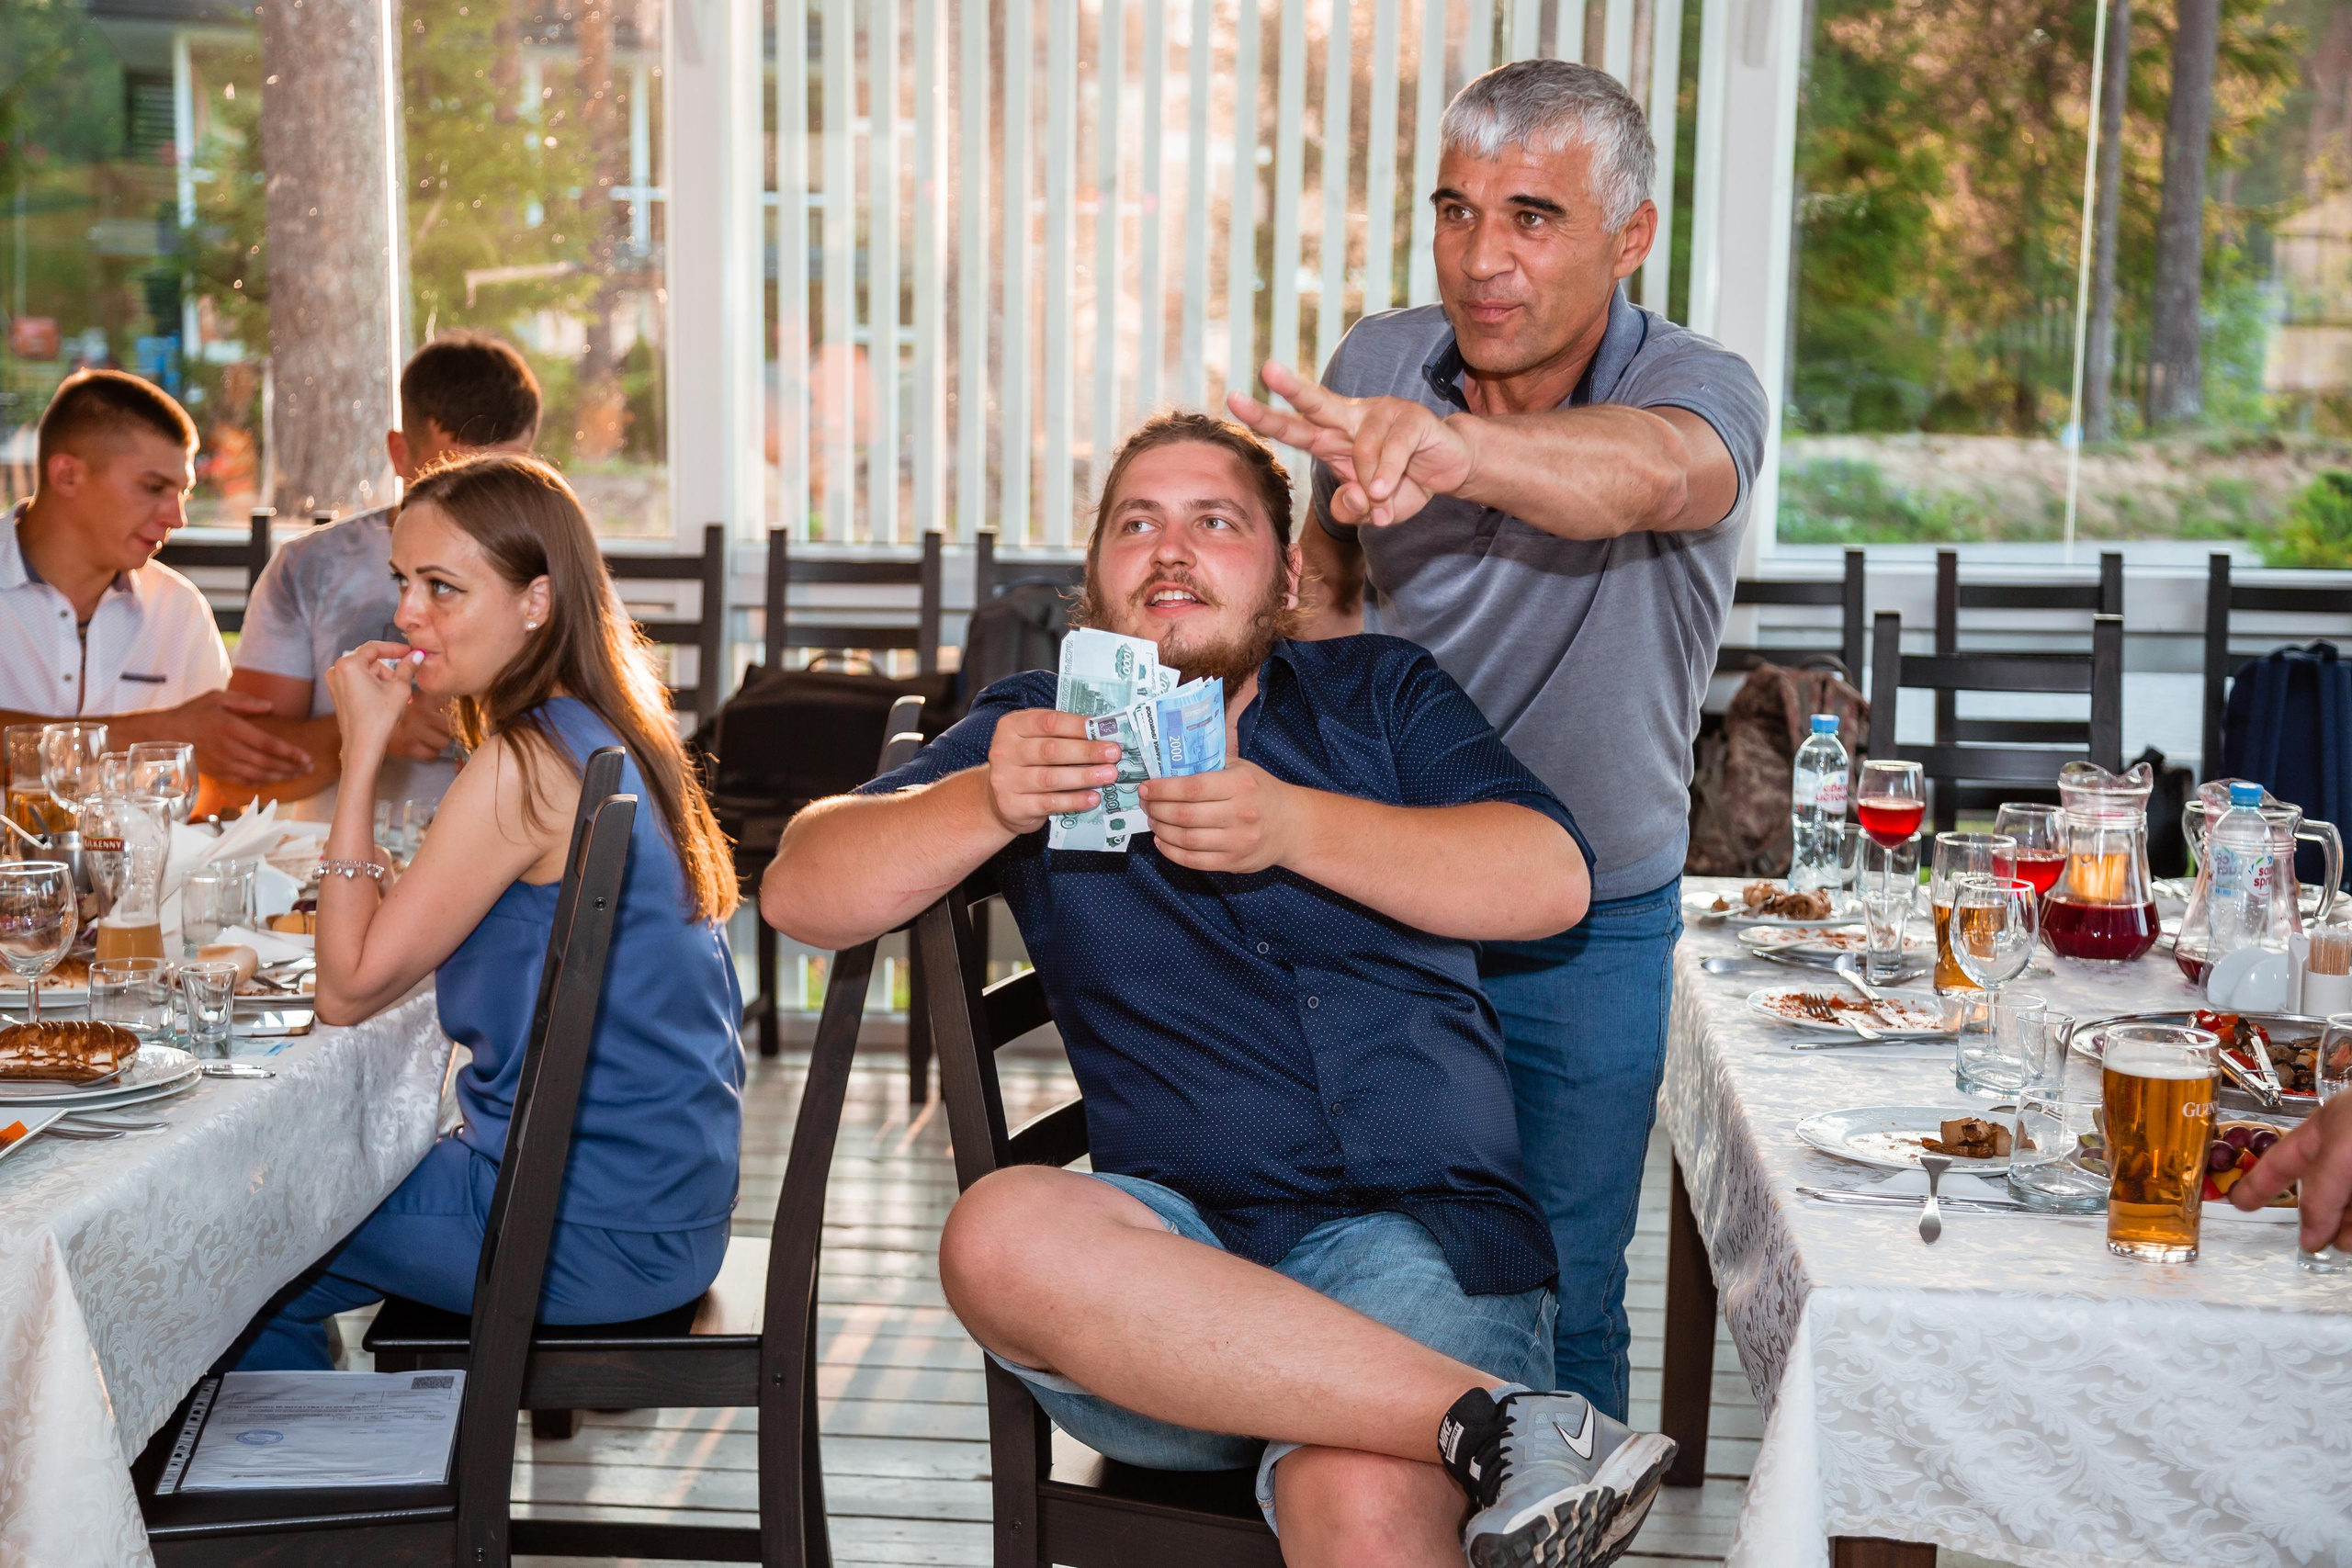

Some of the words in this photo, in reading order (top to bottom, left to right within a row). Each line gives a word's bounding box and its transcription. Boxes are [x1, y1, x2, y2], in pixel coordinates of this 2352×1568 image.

[1123, 649, 1132, 675] 1000
[1169, 736, 1182, 761] 2000
[1102, 784, 1121, 814] 1000
[1439, 1416, 1453, 1452] NIKE
